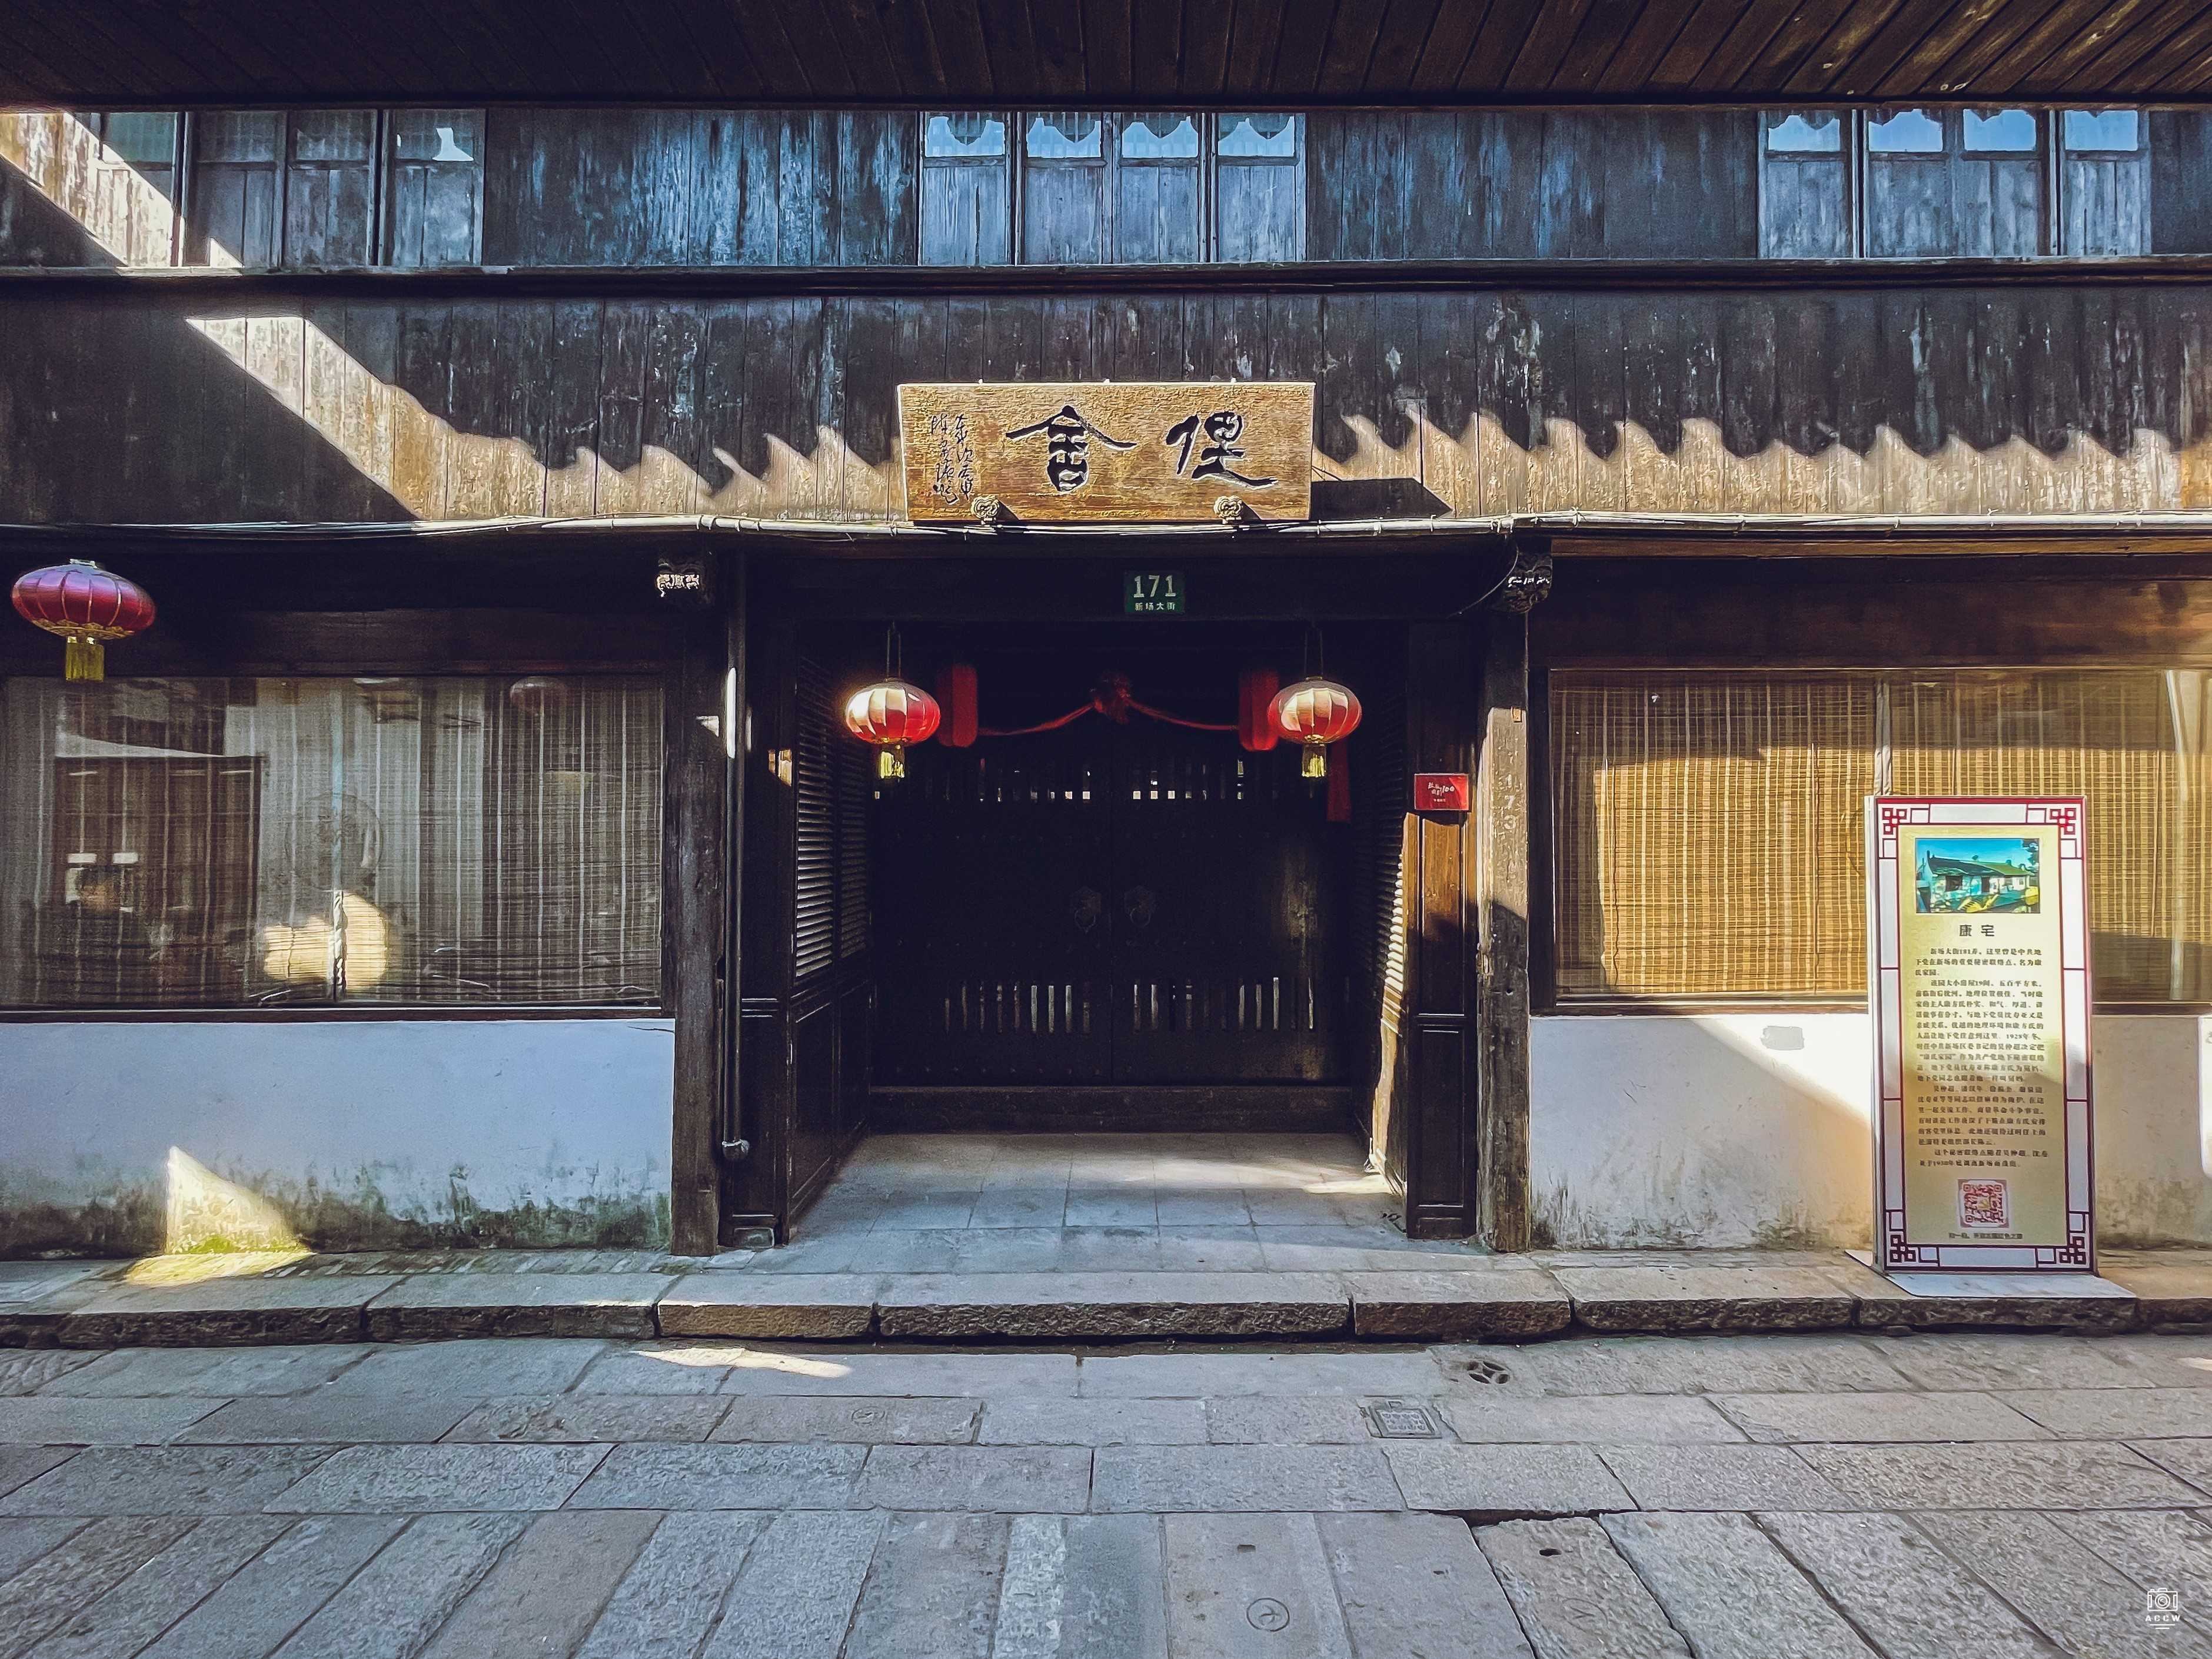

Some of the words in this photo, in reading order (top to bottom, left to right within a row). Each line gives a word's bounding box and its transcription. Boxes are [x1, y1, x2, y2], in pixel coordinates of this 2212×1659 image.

[1133, 575, 1176, 597] 171
[1135, 601, 1175, 611] 新场大街
